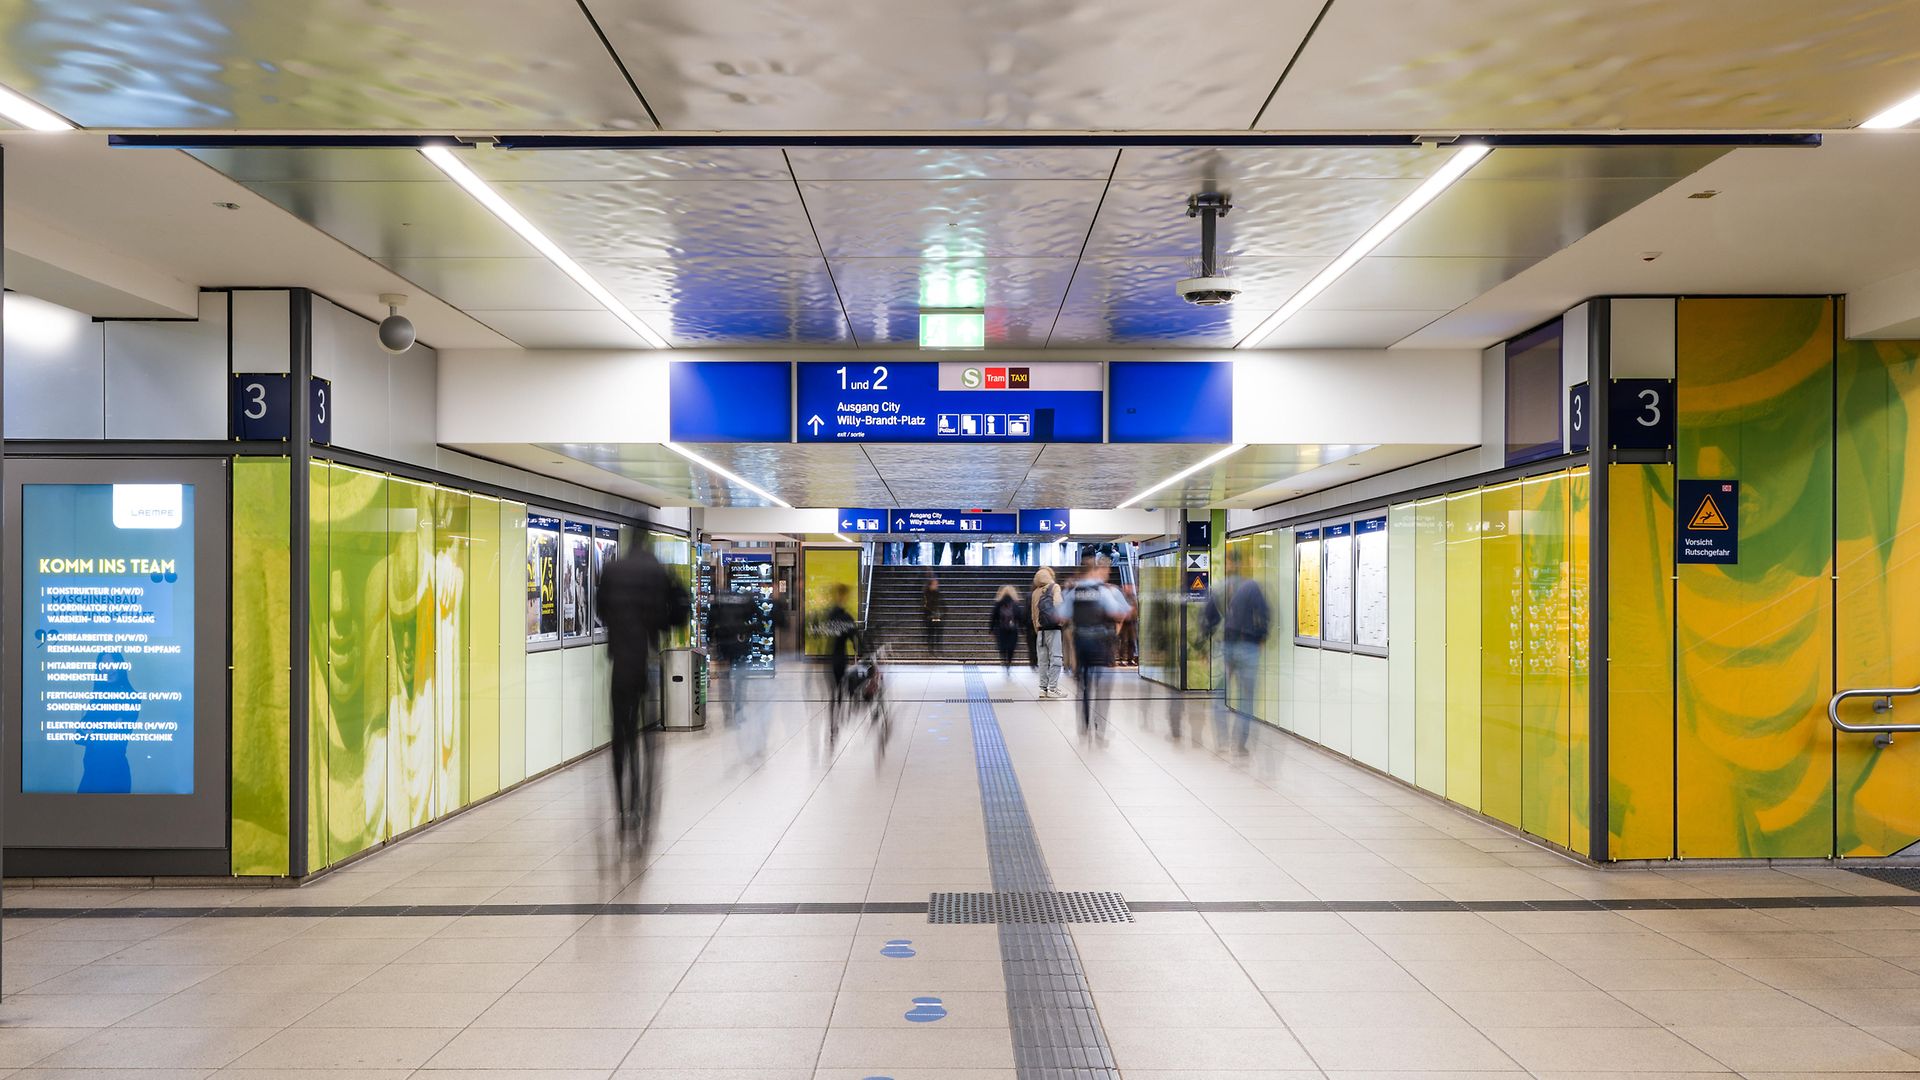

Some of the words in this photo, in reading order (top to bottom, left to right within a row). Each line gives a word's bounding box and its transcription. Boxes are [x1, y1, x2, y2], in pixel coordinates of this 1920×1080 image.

[837, 366, 847, 390] 1
[851, 380, 869, 390] und
[873, 366, 888, 390] 2
[964, 368, 980, 388] S
[986, 374, 1005, 382] Tram
[1010, 374, 1028, 382] TAXI
[244, 383, 267, 420] 3
[317, 388, 326, 424] 3
[837, 402, 880, 414] Ausgang
[881, 402, 901, 414] City
[1573, 394, 1582, 431] 3
[1636, 389, 1661, 427] 3
[837, 415, 926, 427] Willy-Brandt-Platz
[130, 509, 174, 517] LAEMPE
[1200, 524, 1207, 539] 1
[1685, 538, 1713, 546] Vorsicht
[1685, 549, 1730, 557] Rutschgefahr
[39, 558, 94, 574] KOMM
[99, 558, 126, 574] INS
[130, 558, 175, 574] TEAM
[731, 564, 758, 572] snackbox
[47, 587, 109, 595] KONSTRUKTEUR
[110, 586, 144, 596] (M/W/D)
[51, 595, 138, 604] MASCHINENBAU
[47, 604, 108, 612] KOORDINATOR
[109, 603, 142, 613] (M/W/D)
[93, 616, 111, 624] UND
[47, 633, 113, 642] SACHBEARBEITER
[114, 633, 148, 643] (M/W/D)
[47, 645, 122, 654] REISEMANAGEMENT
[124, 645, 142, 654] UND
[143, 645, 181, 654] EMPFANG
[47, 662, 97, 670] MITARBEITER
[98, 661, 132, 671] (M/W/D)
[47, 673, 108, 682] NORMENSTELLE
[46, 691, 147, 700] FERTIGUNGSTECHNOLOGE
[149, 691, 182, 701] (M/W/D)
[46, 703, 141, 711] SONDERMASCHINENBAU
[46, 721, 143, 730] ELEKTROKONSTRUKTEUR
[144, 721, 178, 731] (M/W/D)
[90, 733, 173, 742] STEUERUNGSTECHNIK
